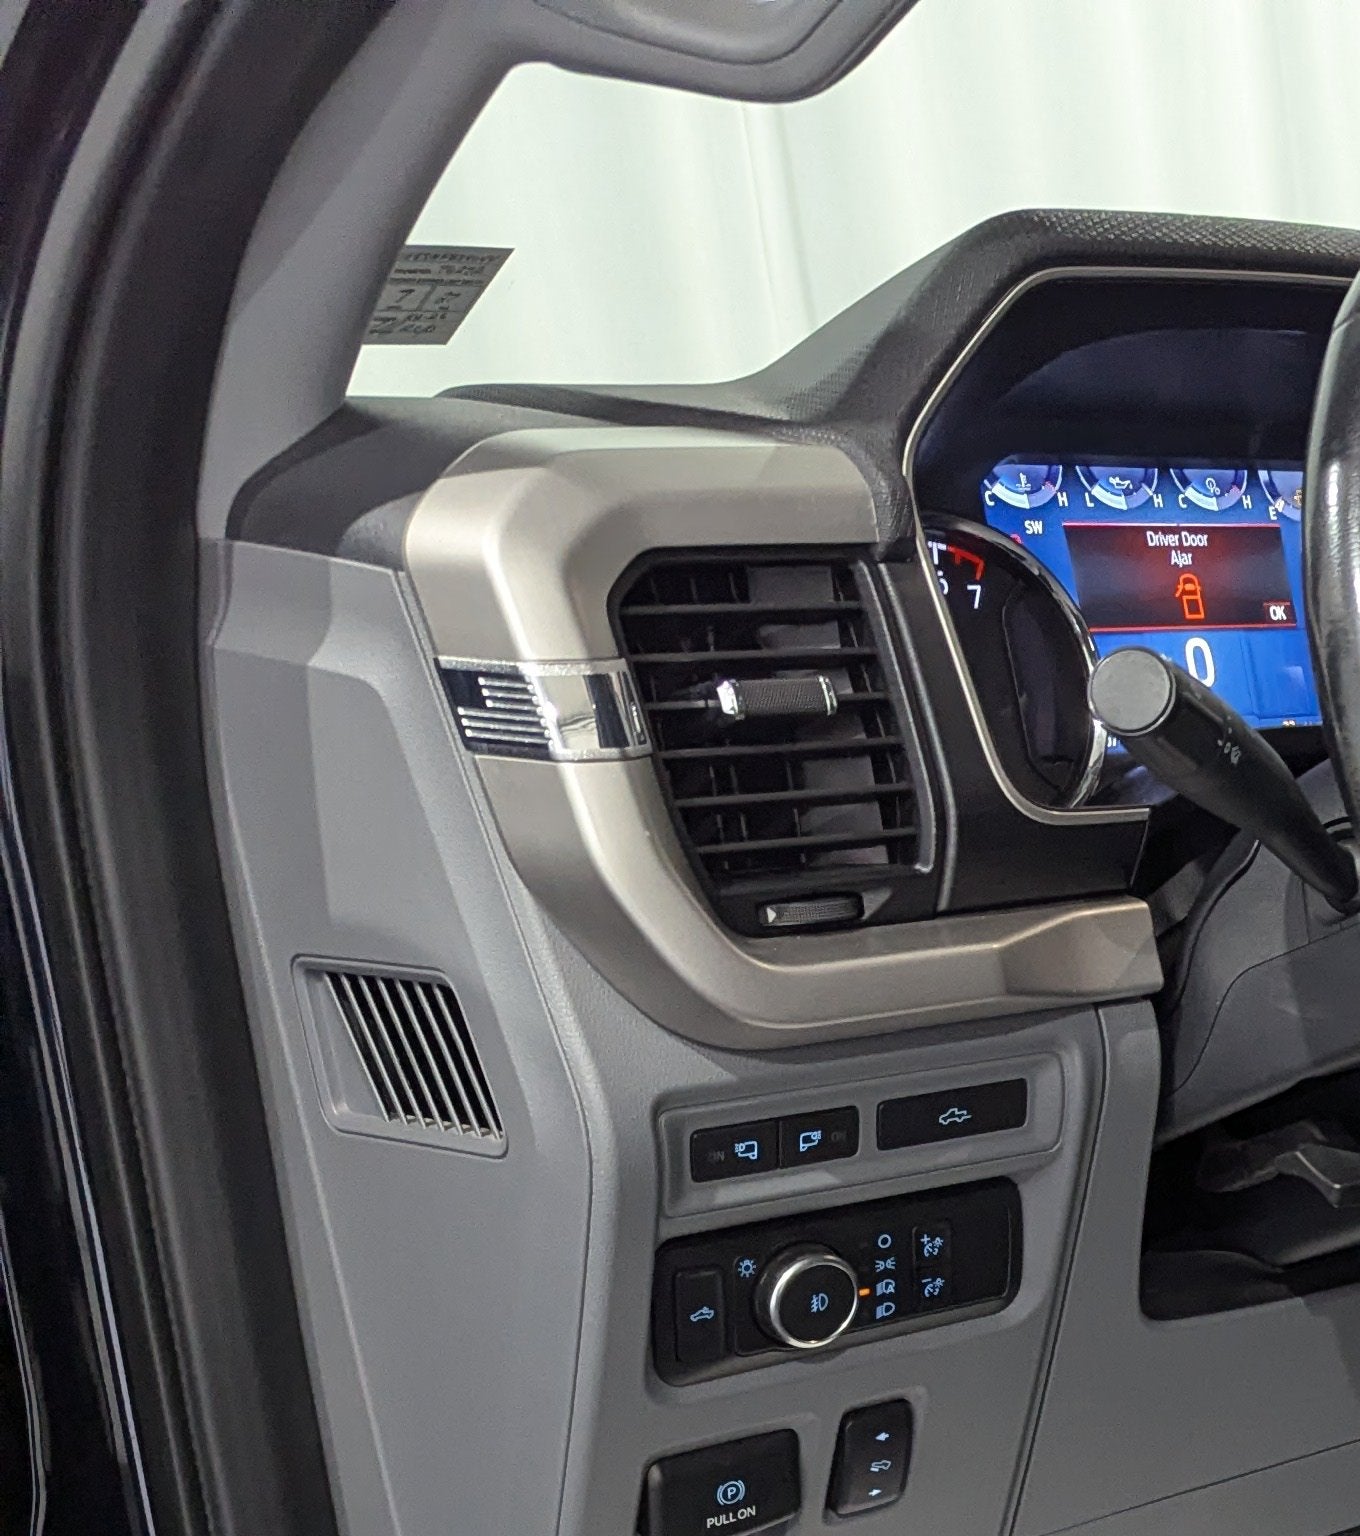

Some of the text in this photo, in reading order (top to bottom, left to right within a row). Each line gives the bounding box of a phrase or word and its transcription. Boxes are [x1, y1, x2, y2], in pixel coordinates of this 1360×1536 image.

[984, 493, 995, 506] C
[1057, 493, 1068, 507] H
[1085, 494, 1094, 507] L
[1154, 494, 1163, 508] H
[1178, 494, 1187, 508] C
[1243, 495, 1251, 509] H
[1269, 506, 1277, 520] E
[1024, 520, 1043, 535] SW
[1146, 531, 1208, 547] Driver Door
[1171, 550, 1192, 567] Ajar
[967, 585, 982, 609] 7
[1269, 605, 1287, 621] OK
[1185, 637, 1215, 688] 0
[706, 1505, 756, 1529] PULL ON
